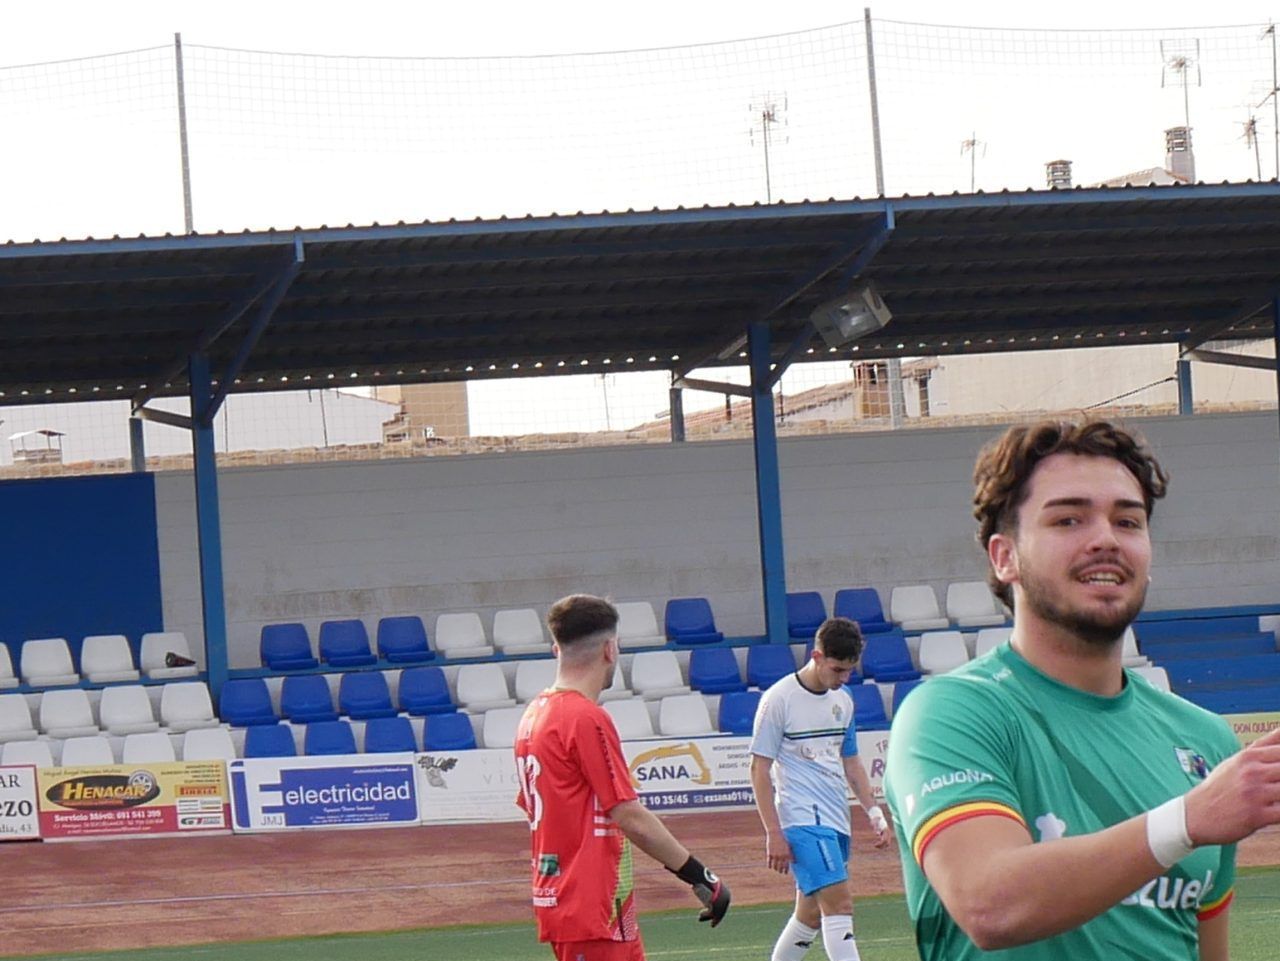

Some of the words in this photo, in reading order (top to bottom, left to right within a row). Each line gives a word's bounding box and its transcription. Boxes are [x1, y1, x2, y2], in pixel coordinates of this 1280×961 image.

[637, 765, 690, 781] SANA
[921, 768, 993, 797] AQUONA
[62, 782, 147, 800] HENACAR
[285, 781, 411, 805] electricidad
[650, 795, 660, 805] 10
[54, 814, 88, 823] Servicio
[260, 816, 284, 826] JMJ
